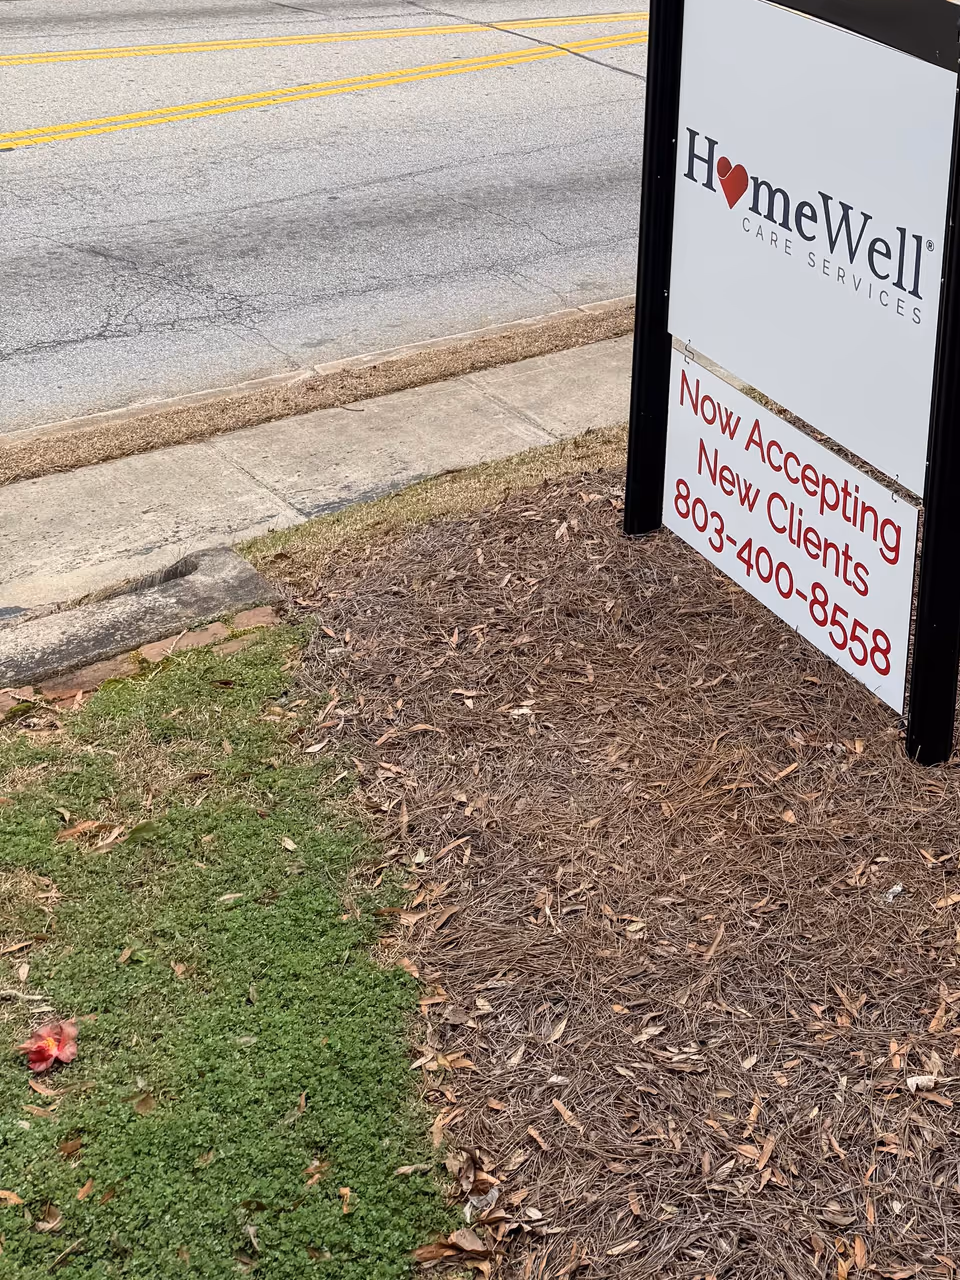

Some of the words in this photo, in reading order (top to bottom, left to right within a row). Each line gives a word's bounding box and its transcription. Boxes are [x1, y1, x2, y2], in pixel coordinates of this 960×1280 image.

[742, 217, 793, 257] CARE
[807, 251, 922, 326] SERVICES
[679, 369, 741, 441] Now
[745, 419, 902, 566] Accepting
[698, 437, 760, 513] New
[766, 491, 870, 598] Clients
[674, 478, 892, 676] 803-400-8558
